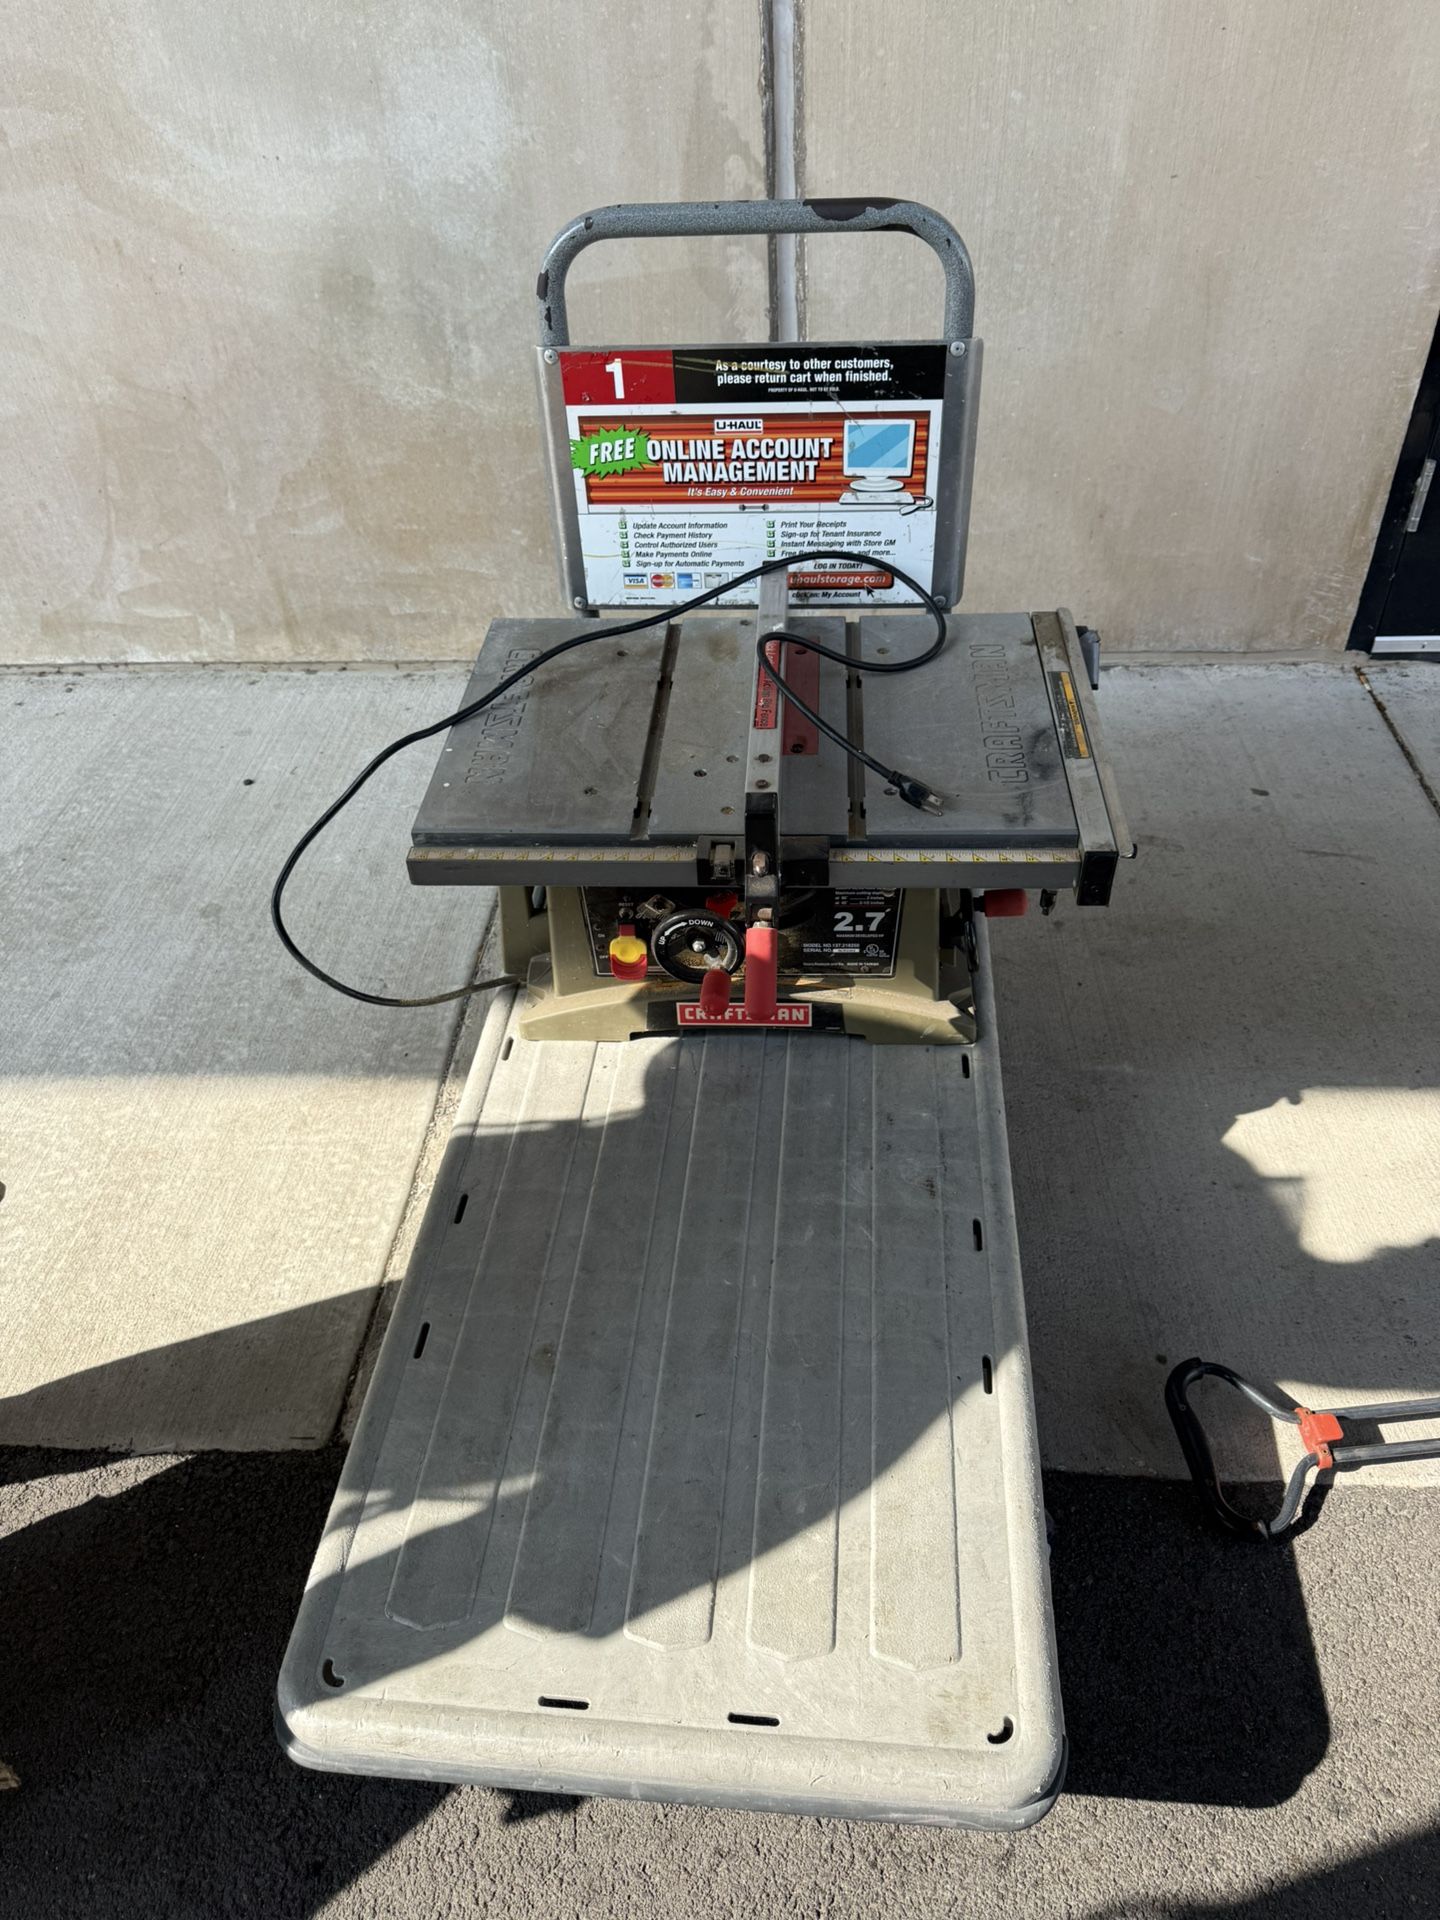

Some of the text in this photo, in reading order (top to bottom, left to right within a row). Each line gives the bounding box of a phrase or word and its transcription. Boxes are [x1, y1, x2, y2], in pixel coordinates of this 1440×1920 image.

[715, 357, 894, 374] As a courtesy to other customers,
[605, 358, 625, 399] 1
[717, 370, 892, 386] please return cart when finished.
[716, 420, 761, 430] U-HAUL
[590, 437, 635, 465] FREE
[647, 437, 834, 461] ONLINE ACCOUNT
[663, 460, 820, 483] MANAGEMENT
[687, 486, 794, 498] It's Easy & Convenient
[632, 521, 728, 530] Update Account Information
[781, 519, 847, 528] Print Your Receipts
[633, 531, 713, 541] Check Payment History
[780, 529, 881, 539] Sign-up for Tenant Insurance
[634, 541, 718, 549] Control Authorized Users
[781, 538, 896, 549] Instant Messaging with Store GM
[655, 550, 689, 559] Payments
[690, 550, 712, 558] Online
[781, 550, 797, 558] Free
[636, 559, 745, 569] Sign-up for Automatic Payments
[814, 562, 864, 570] LOG IN TODAY!
[821, 591, 832, 599] My
[688, 919, 714, 927] DOWN
[833, 912, 886, 931] 2.7
[658, 936, 666, 945] UP
[684, 1007, 805, 1021] CRFTAN
